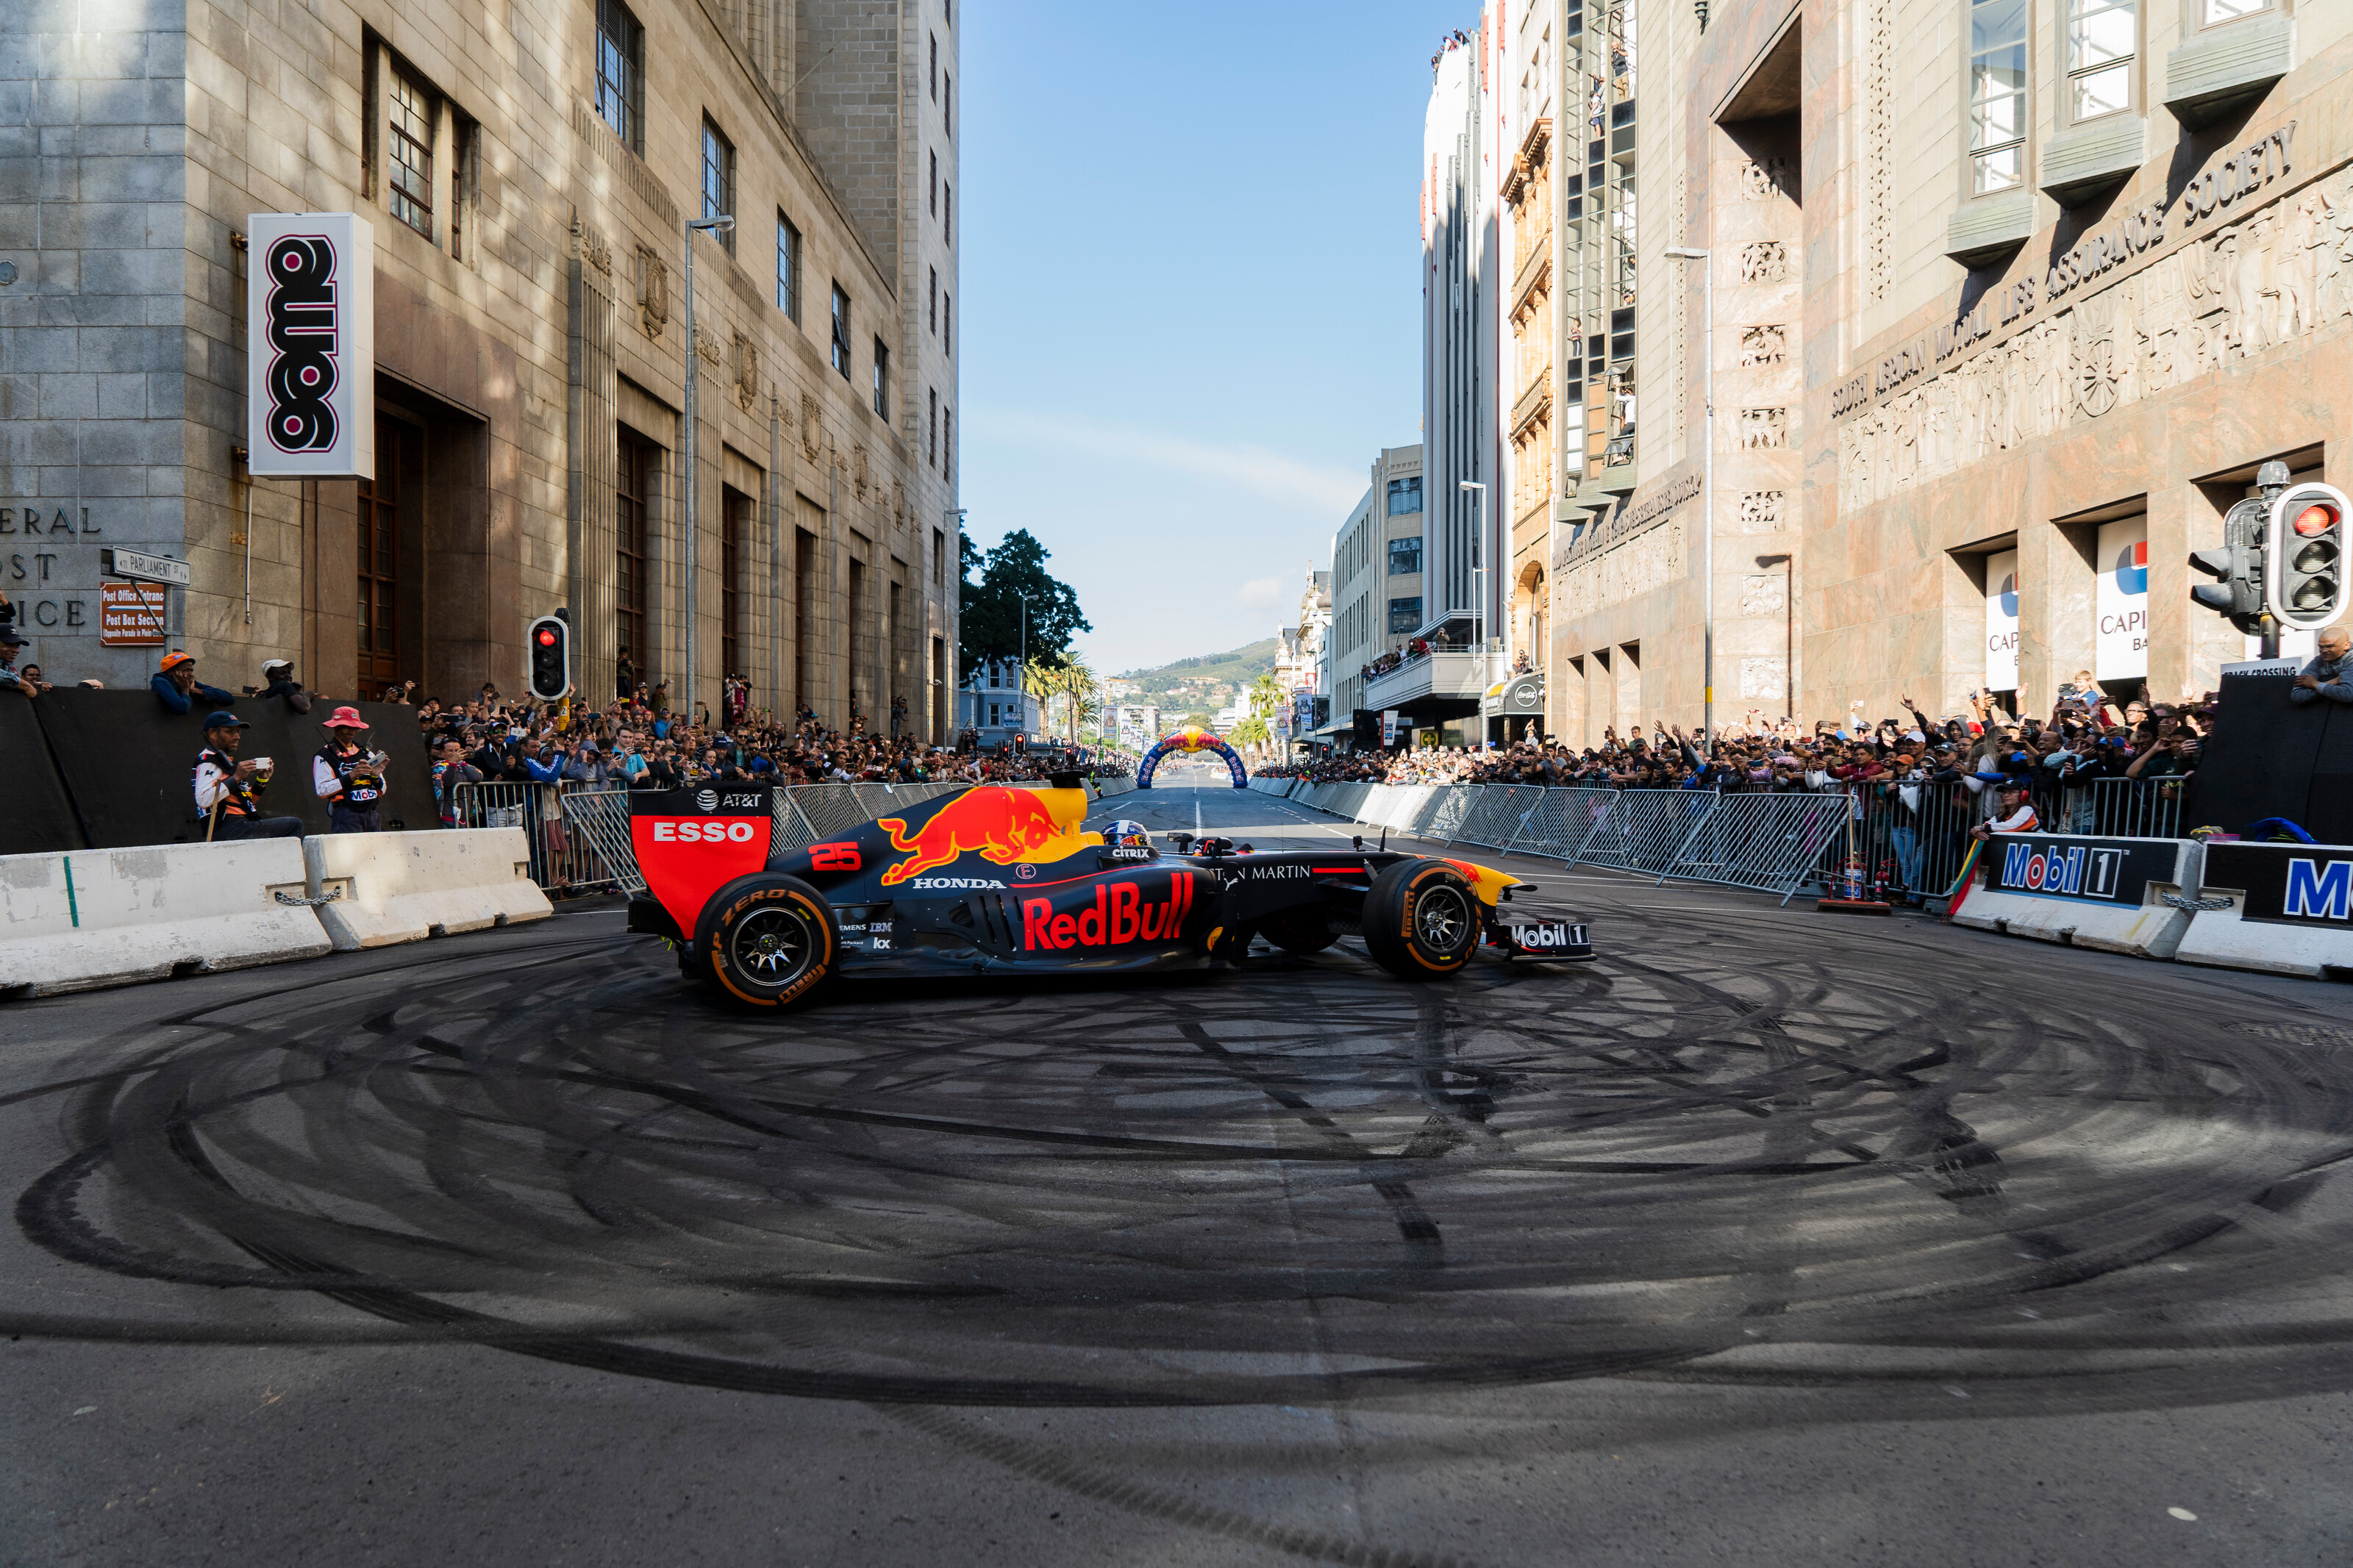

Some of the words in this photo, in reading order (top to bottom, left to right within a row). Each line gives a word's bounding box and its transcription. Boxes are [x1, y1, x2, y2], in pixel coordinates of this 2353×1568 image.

[1832, 373, 1868, 416] SOUTH
[1876, 340, 1925, 393] AFRICAN
[1935, 303, 1991, 360] MUTUAL
[2001, 276, 2035, 321] LIFE
[2048, 198, 2166, 298] ASSURANCE
[2185, 118, 2299, 223] SOCIETY
[265, 235, 339, 454] game
[130, 556, 171, 578] PARLIAMENT
[174, 565, 179, 574] ST
[103, 590, 116, 601] Post
[118, 590, 136, 601] Office
[106, 614, 121, 626] Post
[123, 614, 135, 626] Box
[723, 794, 762, 807] AT&T
[654, 823, 754, 842] ESSO
[808, 842, 862, 871] 25
[1252, 865, 1310, 879] MARTIN
[2001, 843, 2086, 894] Mobil
[913, 878, 1007, 889] HONDA
[722, 889, 787, 927] ZERO
[1402, 891, 1415, 937] PIRELLI
[869, 923, 893, 932] IBM
[1512, 925, 1566, 946] Mobil
[873, 937, 890, 949] kx
[779, 964, 826, 1004] PIRELLI
